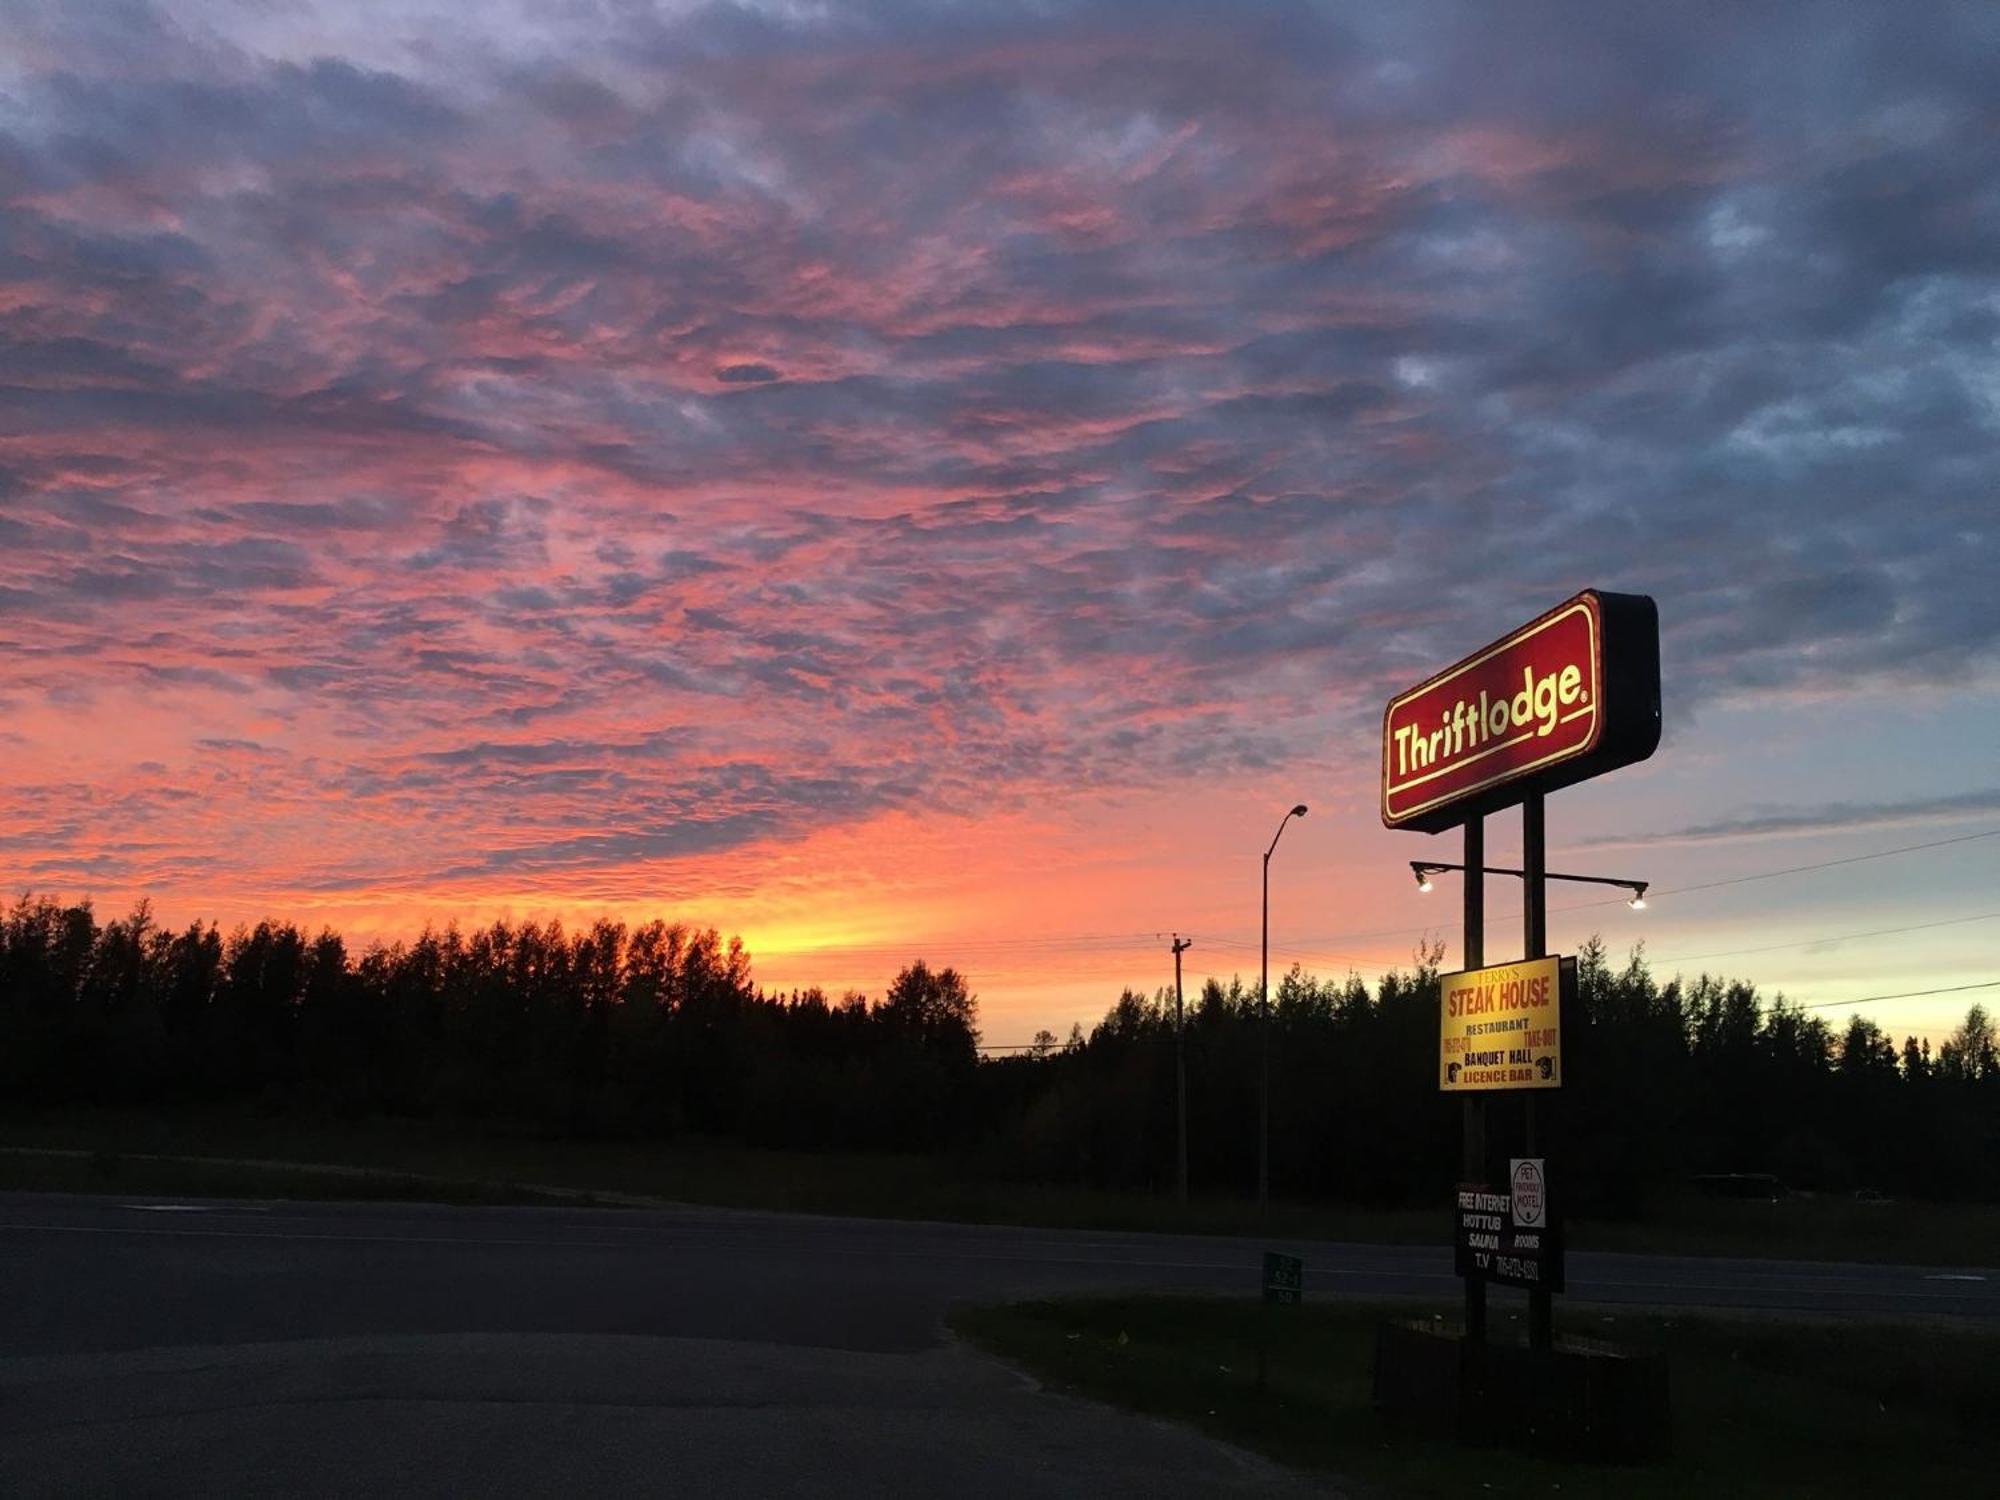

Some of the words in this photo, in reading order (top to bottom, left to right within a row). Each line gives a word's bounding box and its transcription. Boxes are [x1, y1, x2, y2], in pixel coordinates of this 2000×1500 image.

[1394, 665, 1581, 776] Thriftlodge
[1448, 984, 1495, 1018] STEAK
[1500, 976, 1550, 1011] HOUSE
[1466, 1018, 1530, 1036] RESTAURANT
[1464, 1051, 1505, 1067] BANQUET
[1509, 1049, 1533, 1064] HALL
[1463, 1069, 1507, 1083] LICENCE
[1509, 1069, 1532, 1081] BAR
[1458, 1192, 1475, 1209] FREE
[1475, 1193, 1511, 1214] INTERNET
[1468, 1233, 1499, 1250] SAUNA
